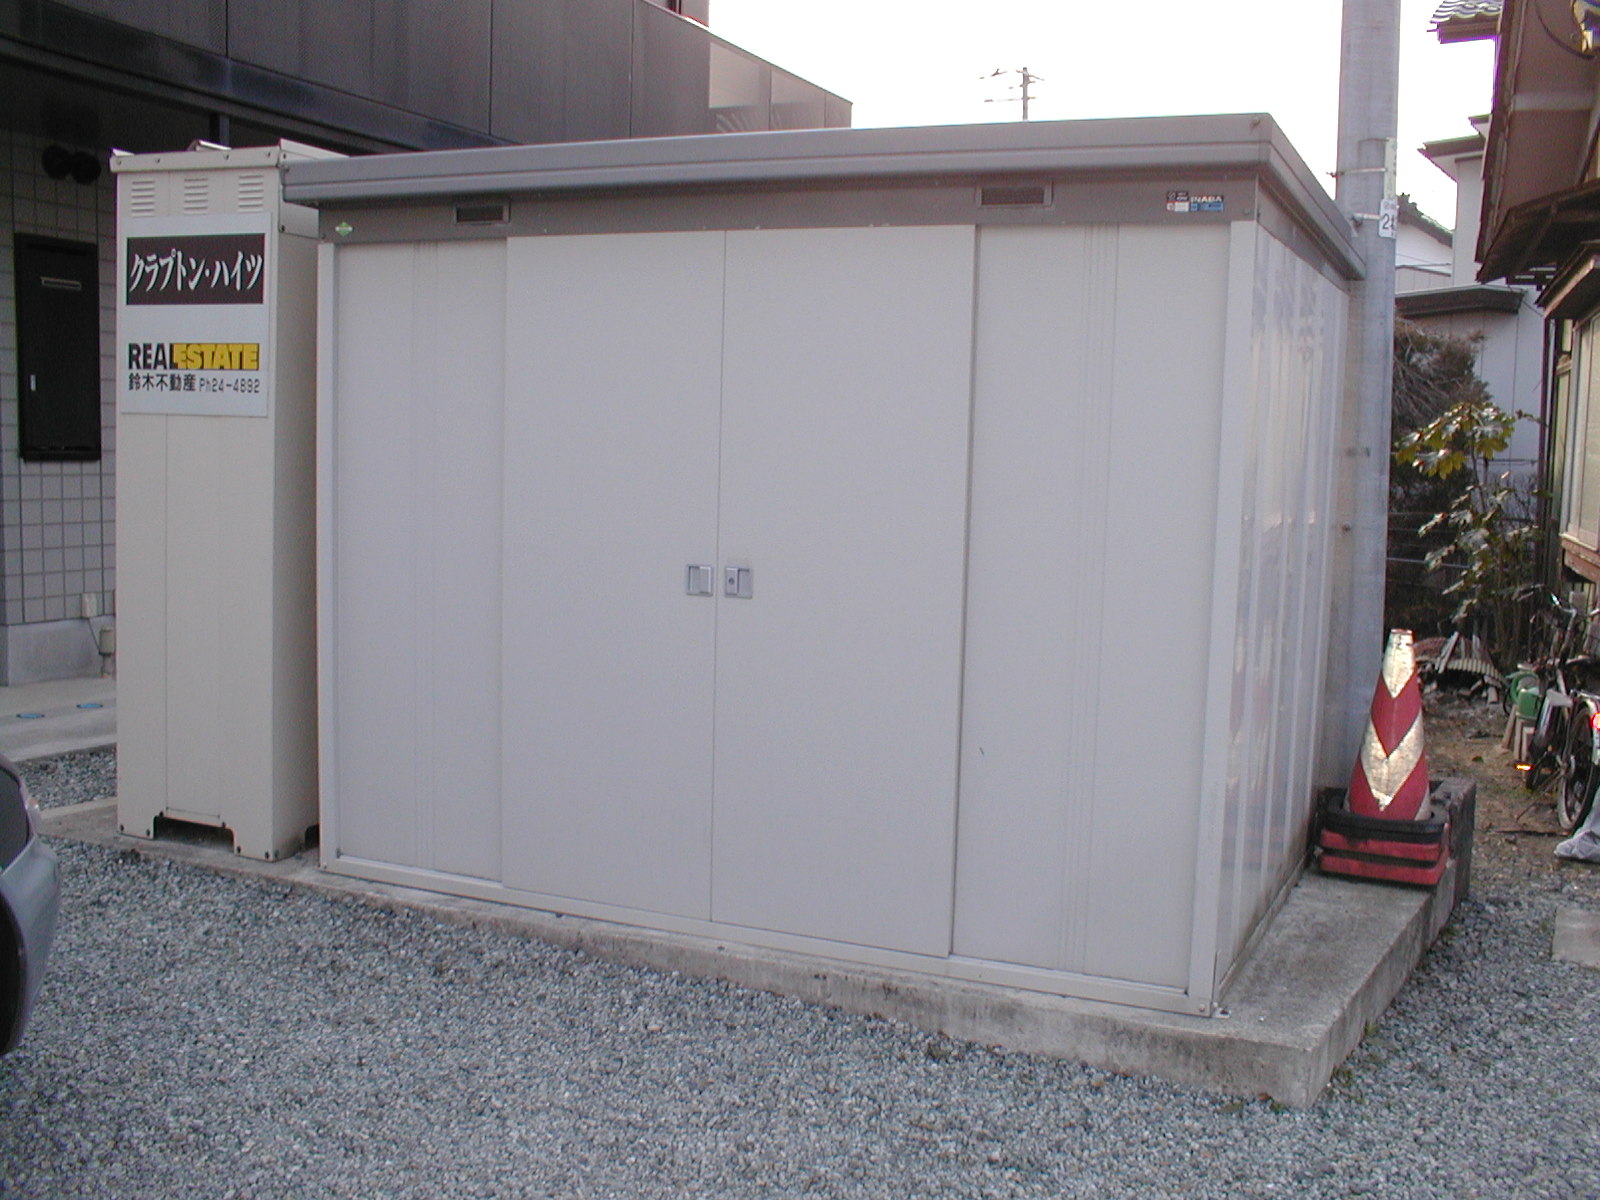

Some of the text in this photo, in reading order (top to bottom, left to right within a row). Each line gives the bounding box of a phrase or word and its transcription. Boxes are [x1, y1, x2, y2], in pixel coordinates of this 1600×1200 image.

[128, 343, 260, 371] REAL ESTATE
[128, 373, 197, 392] 鈴木不動産
